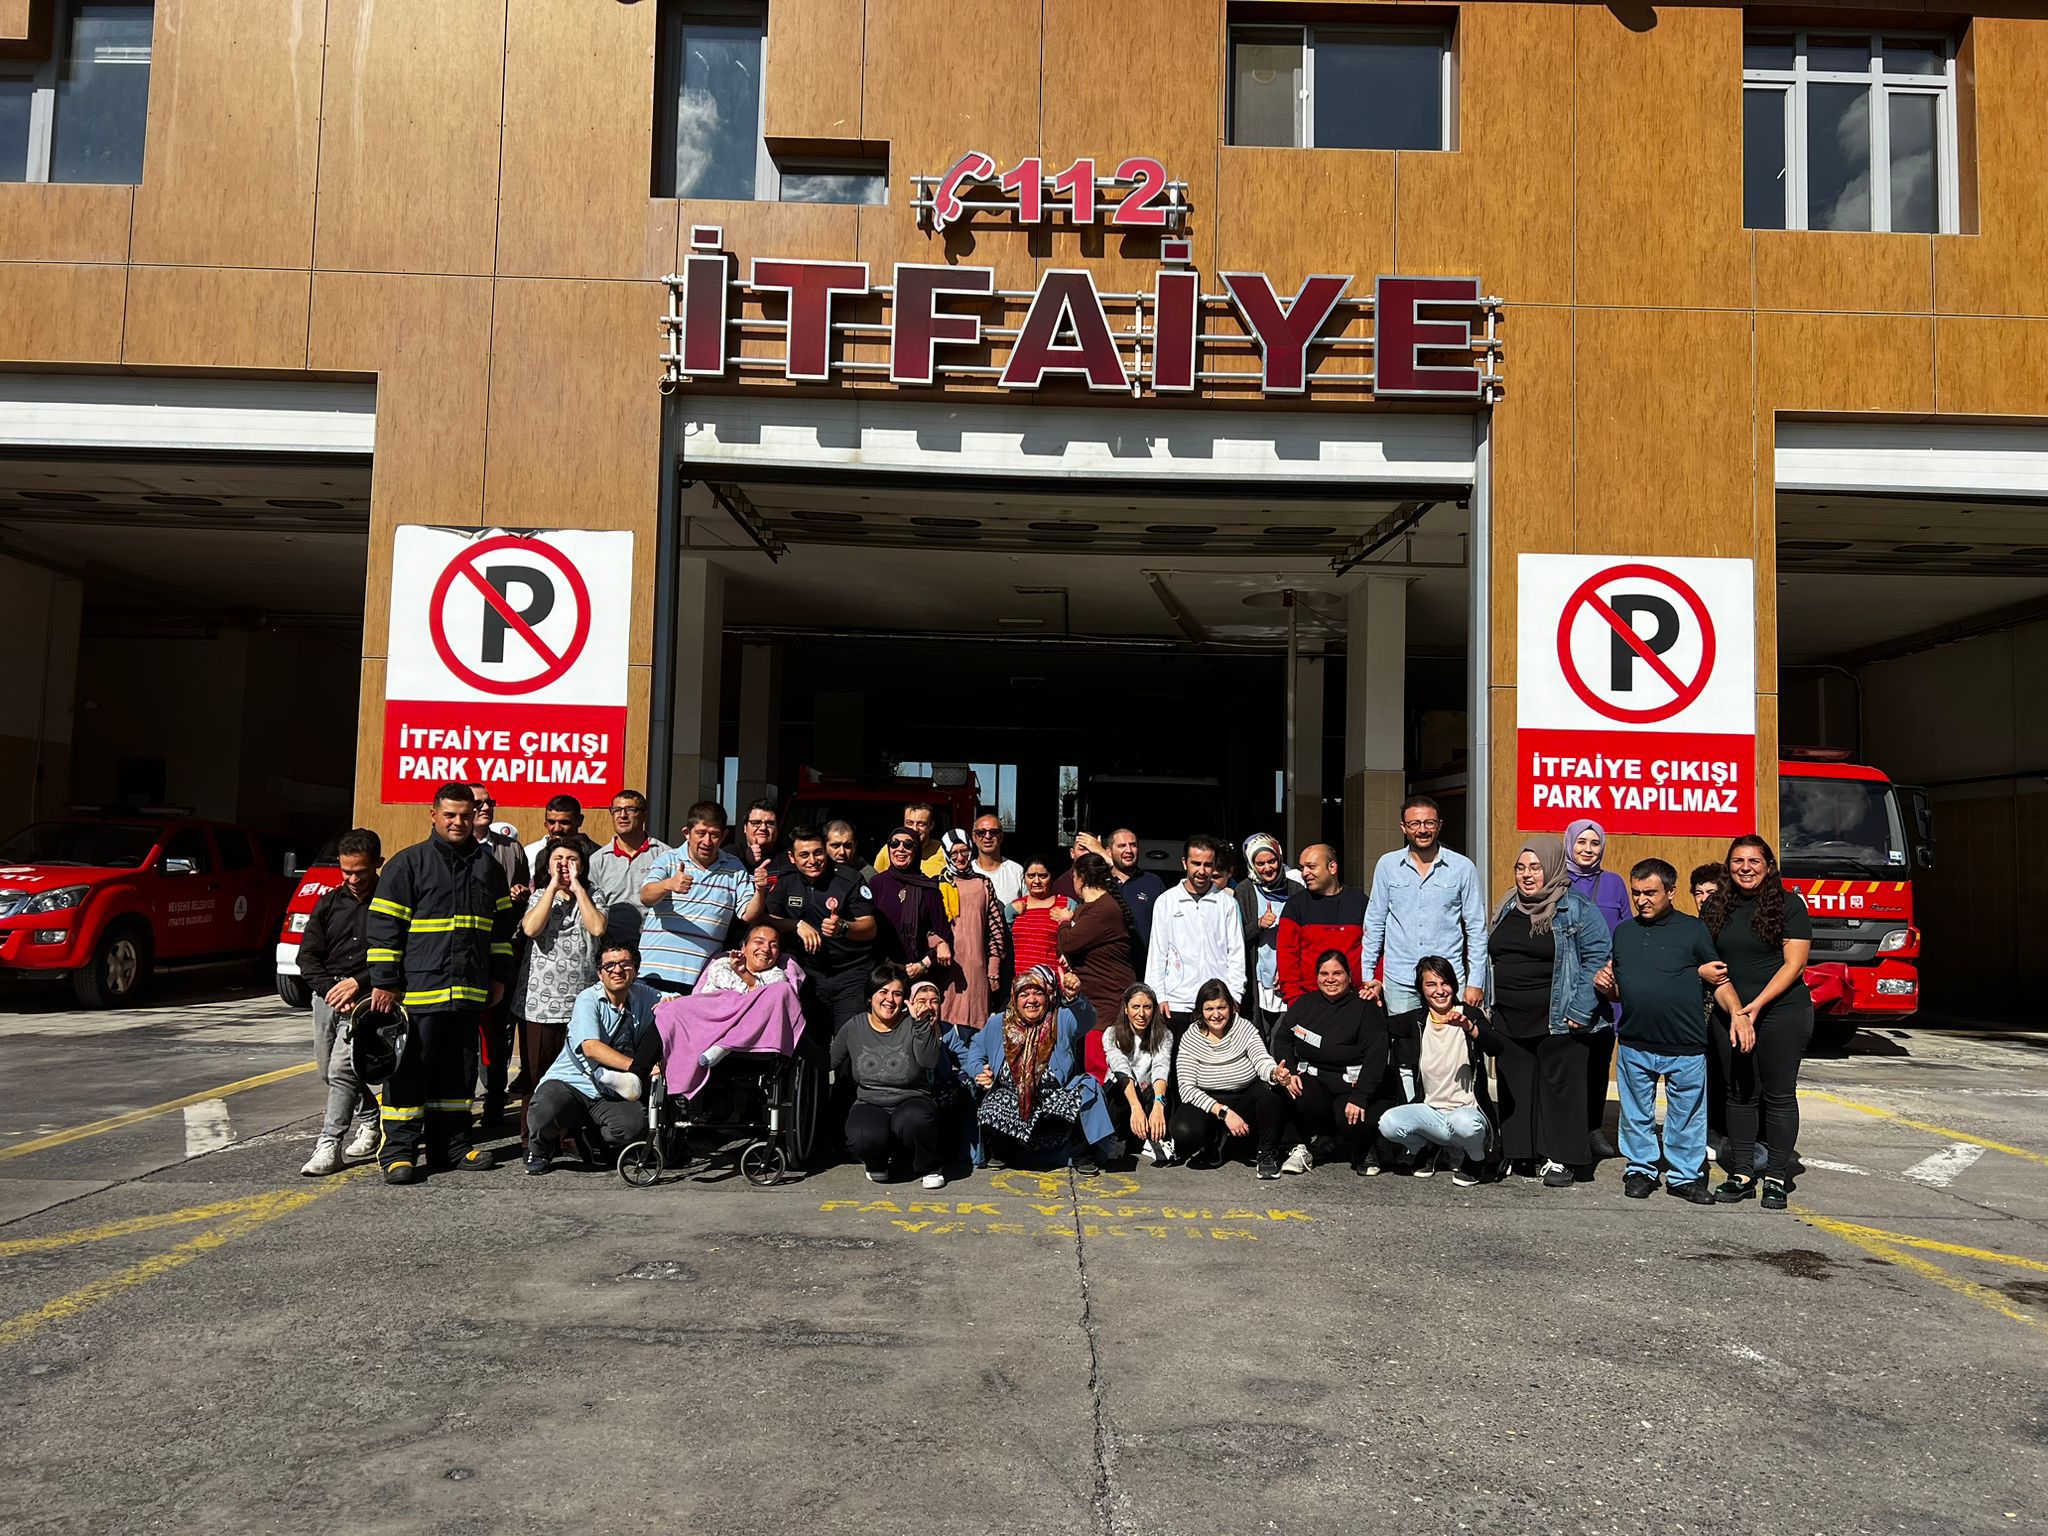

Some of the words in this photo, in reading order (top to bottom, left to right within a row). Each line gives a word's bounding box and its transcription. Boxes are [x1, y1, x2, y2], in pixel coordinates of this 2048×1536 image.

[1001, 157, 1167, 226] 112
[680, 225, 1482, 397] İTFAİYE
[399, 723, 511, 751] İTFAİYE
[519, 731, 609, 759] ÇIKIŞI
[399, 755, 468, 782] PARK
[476, 758, 607, 785] YAPILMAZ
[1532, 752, 1641, 780] İTFAİYE
[1650, 760, 1738, 786] ÇIKIŞI
[1533, 783, 1602, 810] PARK
[1608, 785, 1738, 813] YAPILMAZ
[819, 1200, 1002, 1214] PARK
